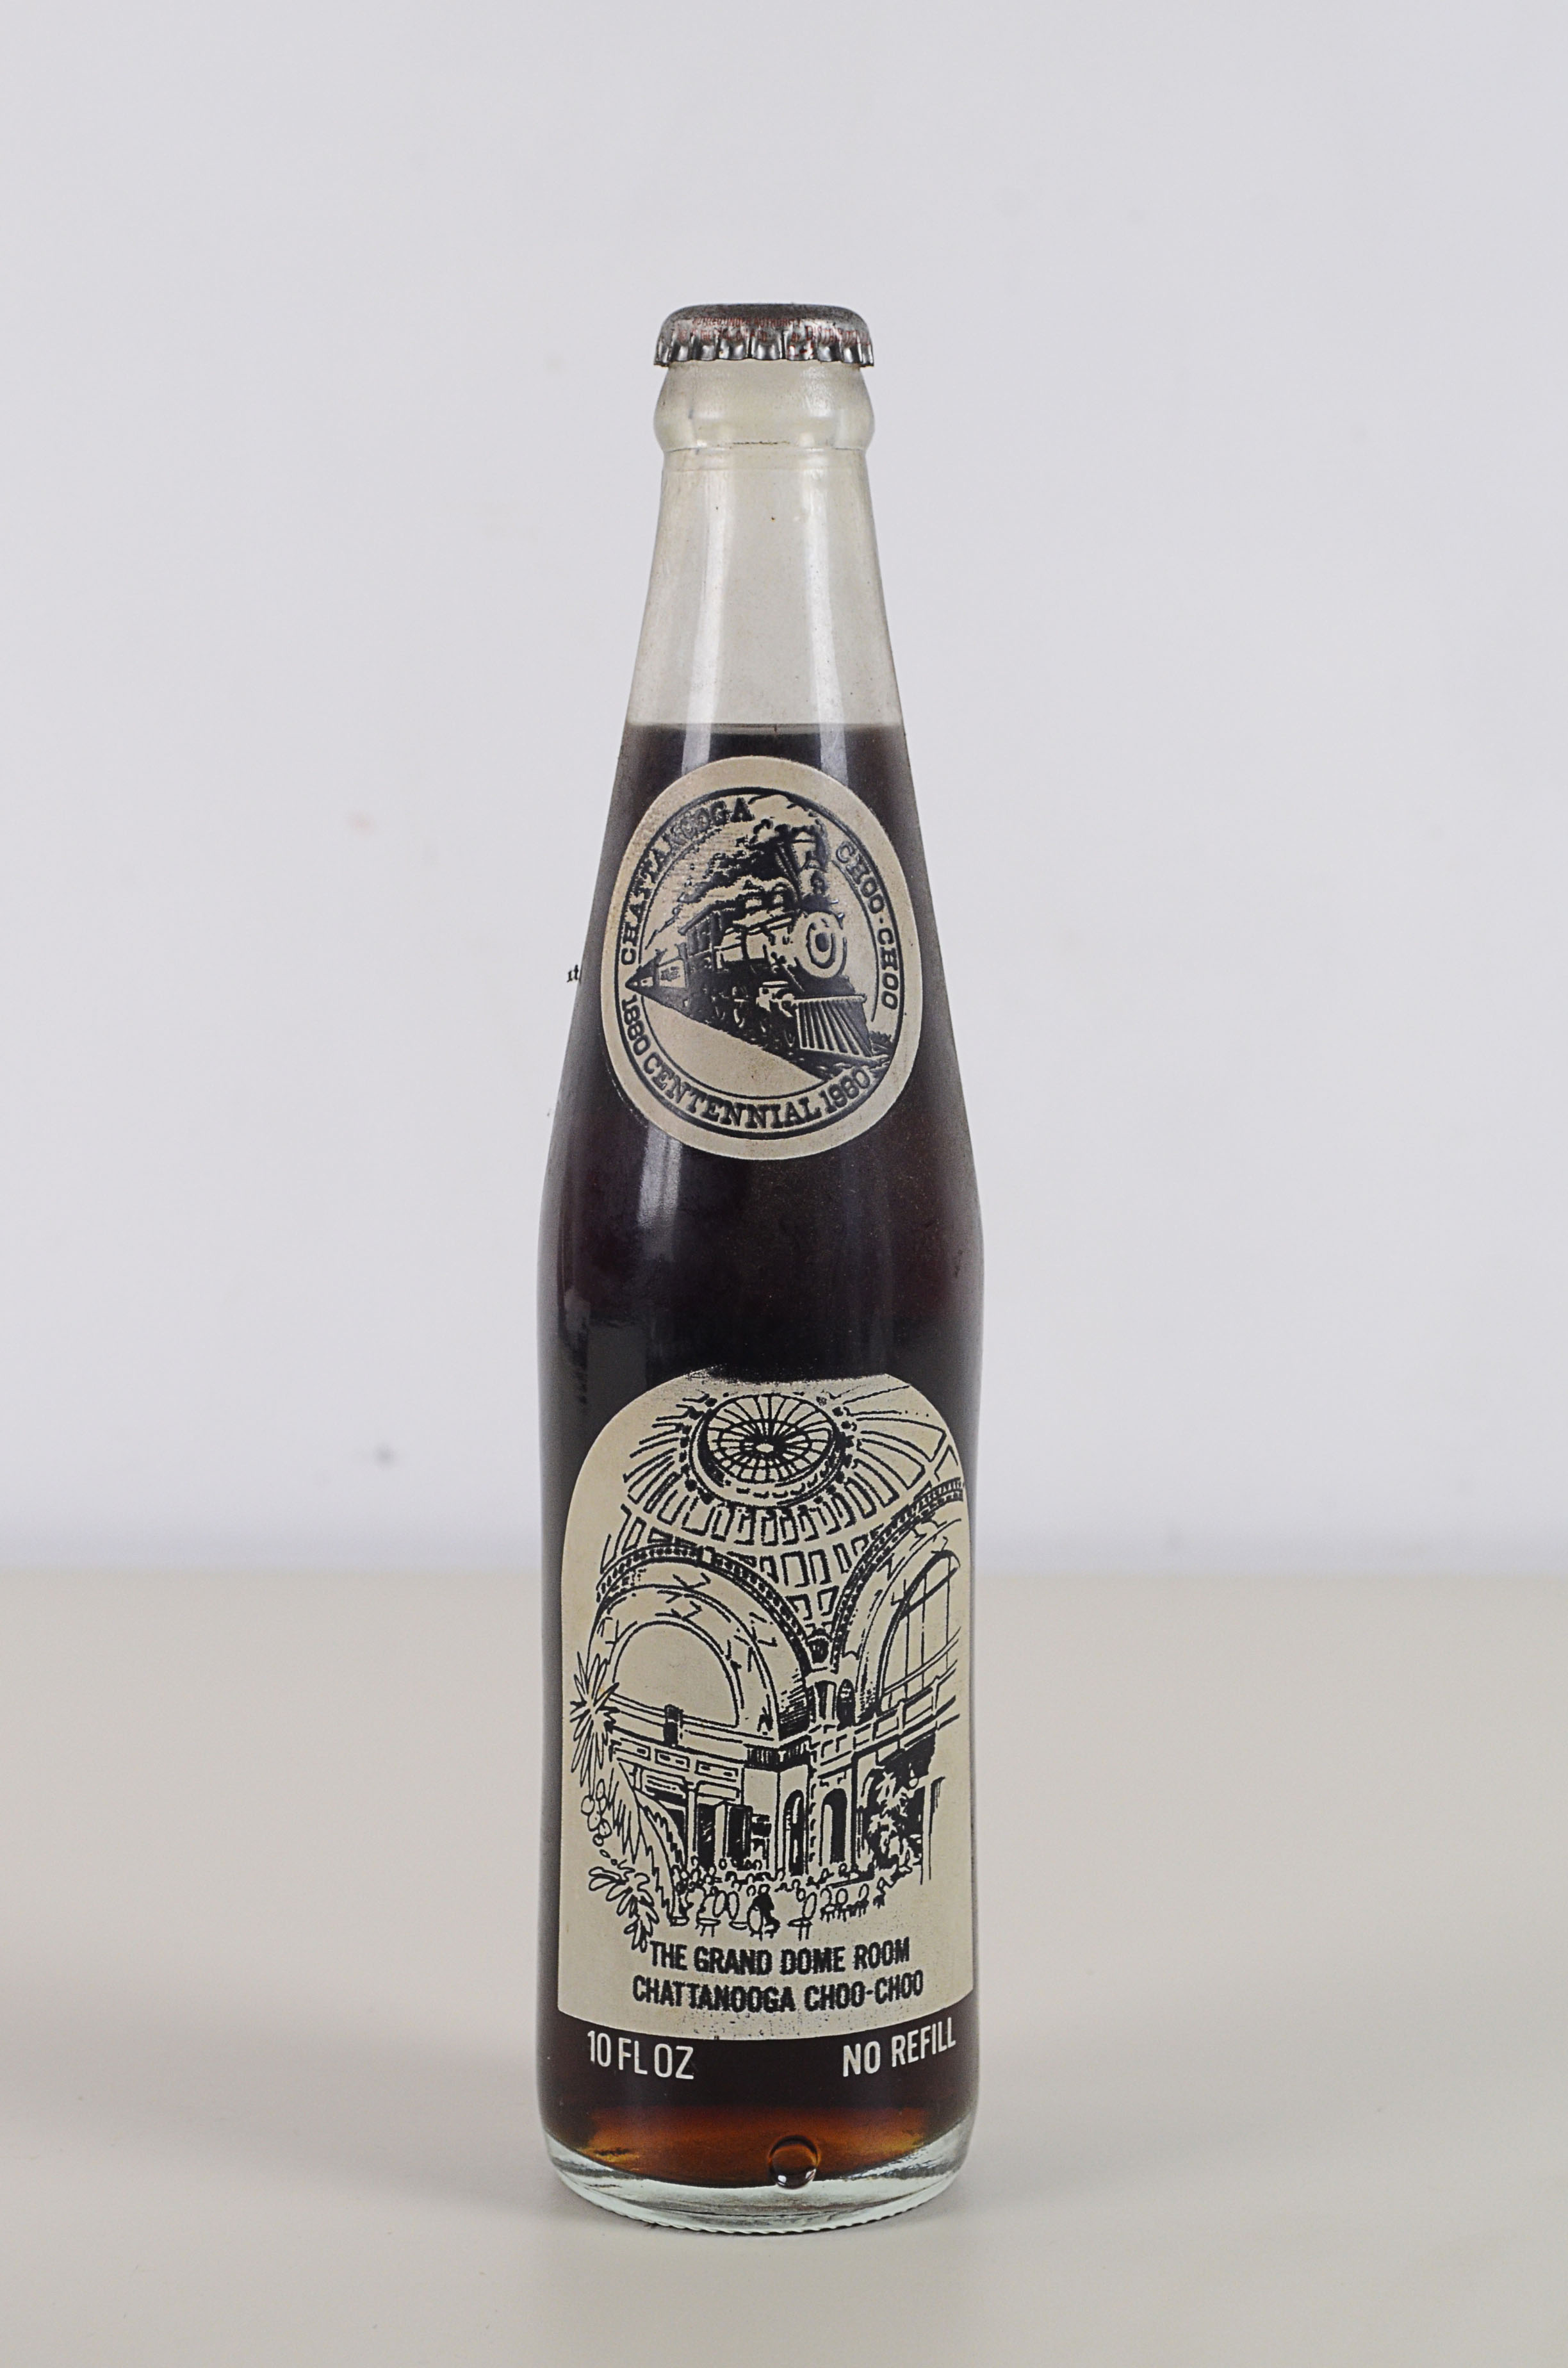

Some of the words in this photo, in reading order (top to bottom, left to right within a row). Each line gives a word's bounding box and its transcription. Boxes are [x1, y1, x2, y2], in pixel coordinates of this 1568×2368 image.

[621, 994, 651, 1057] 1880
[643, 1052, 821, 1129] CENTENNIAL
[818, 1066, 870, 1115] 1980
[649, 1940, 688, 1971] THE
[694, 1945, 773, 1975] GRAND
[780, 1946, 846, 1975] DOME
[853, 1937, 910, 1970] ROOM
[632, 1975, 796, 2012] CHATTANOOGA
[804, 1969, 924, 2012] CHOO-CHOO
[587, 2030, 611, 2068] 10
[618, 2038, 648, 2075] FL
[654, 2043, 694, 2080] OZ
[842, 2041, 881, 2077] NO
[891, 2016, 956, 2067] REFILL
